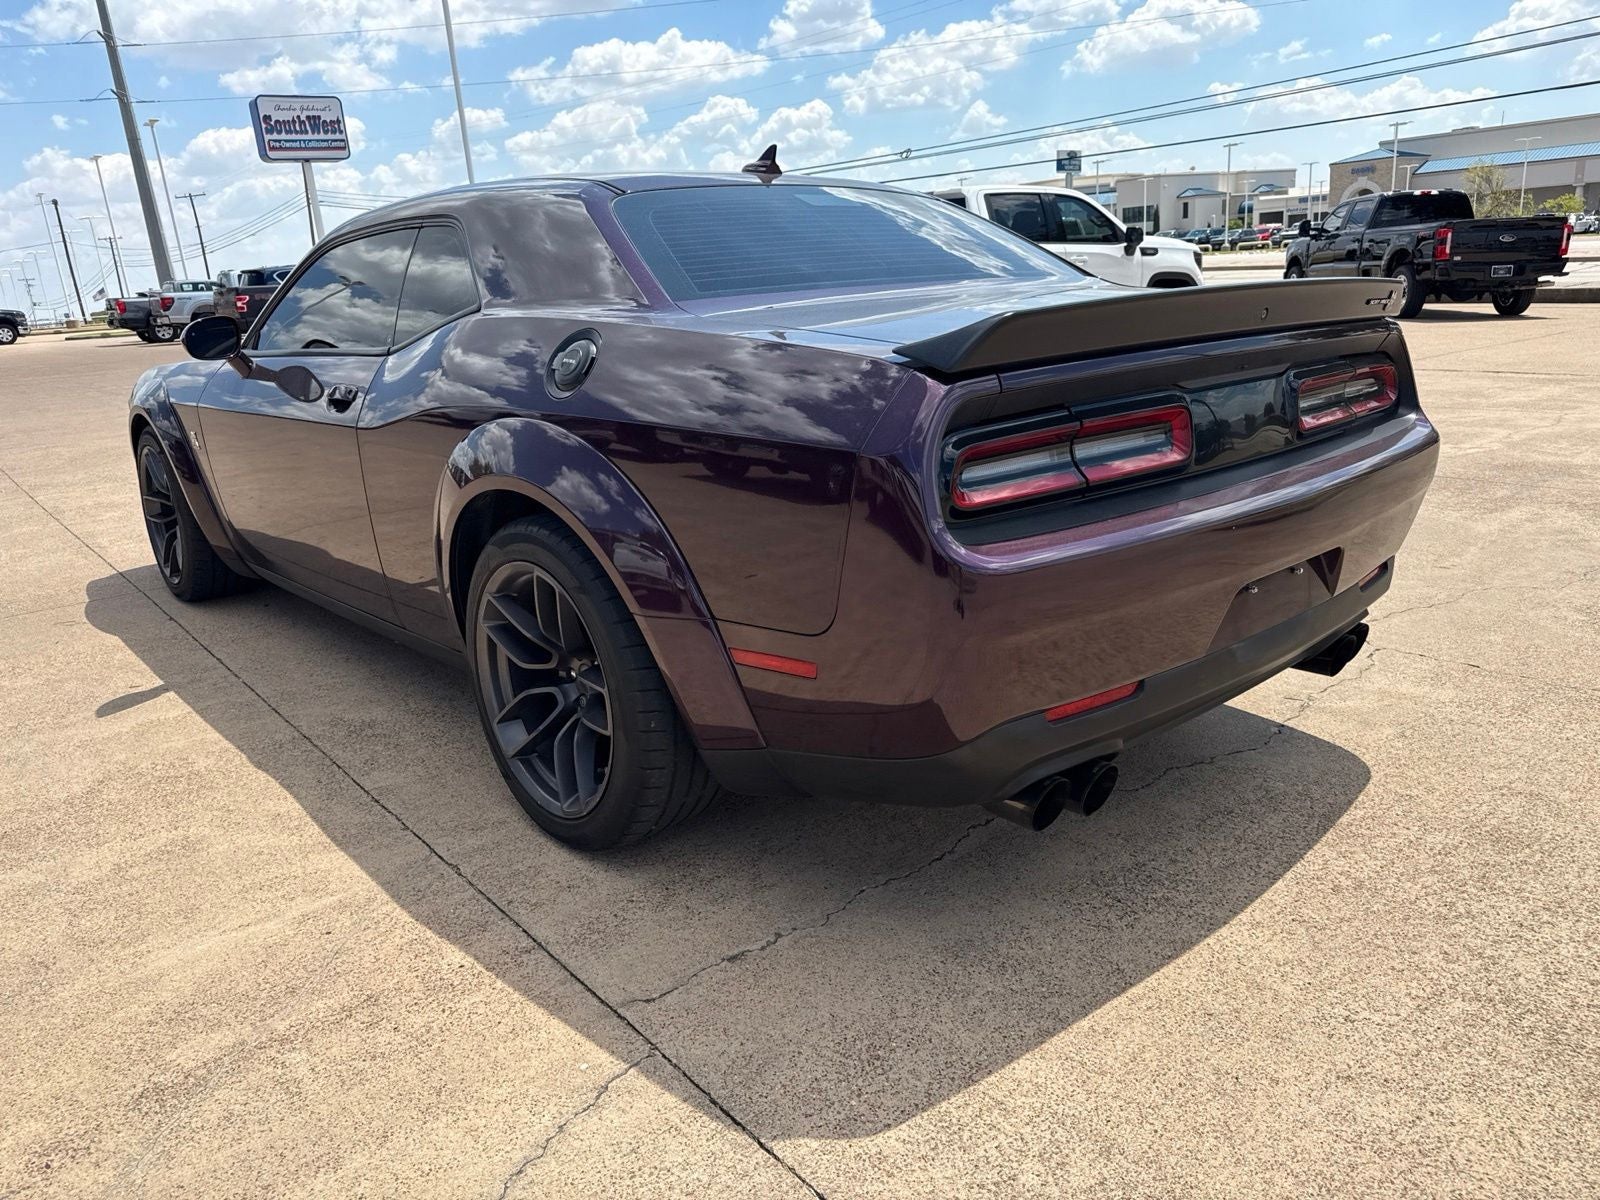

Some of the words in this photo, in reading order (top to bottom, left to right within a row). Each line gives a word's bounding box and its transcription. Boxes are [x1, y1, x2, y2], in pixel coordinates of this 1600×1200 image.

[273, 103, 297, 112] Charlie
[262, 114, 344, 135] SouthWest
[270, 140, 300, 148] Pre-Owned
